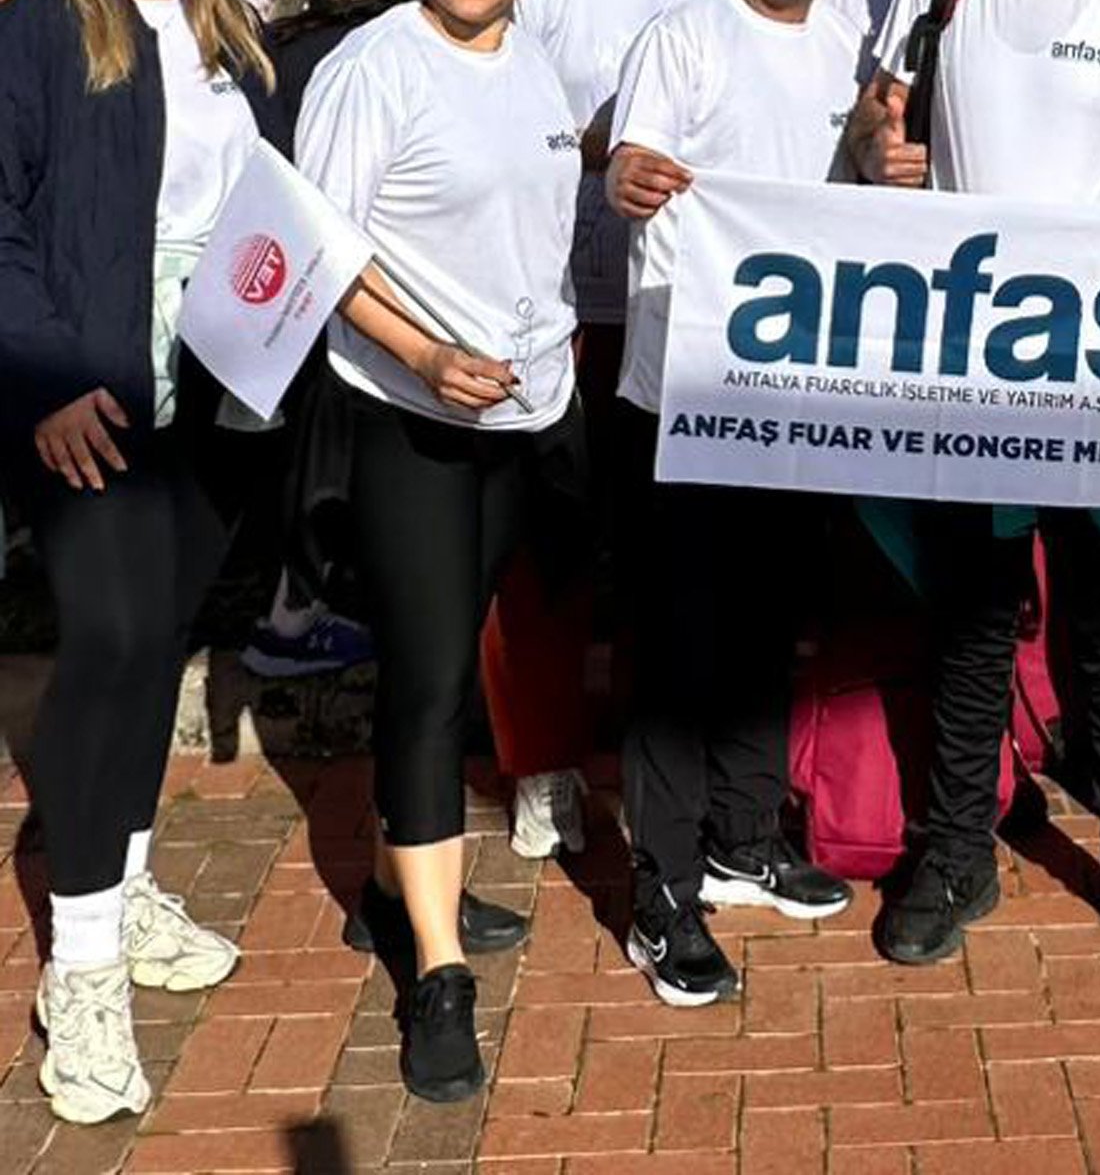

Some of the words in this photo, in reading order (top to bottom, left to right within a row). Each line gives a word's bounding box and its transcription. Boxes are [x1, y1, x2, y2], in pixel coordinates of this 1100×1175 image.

[723, 370, 801, 391] ANTALYA
[805, 376, 898, 398] FUARCILIK
[901, 380, 973, 404] İŞLETME
[978, 390, 1000, 406] VE
[1006, 390, 1074, 410] YATIRIM
[669, 413, 780, 447] ANFAŞ
[788, 421, 873, 450] FUAR
[882, 428, 925, 454] VE
[932, 432, 1065, 462] KONGRE
